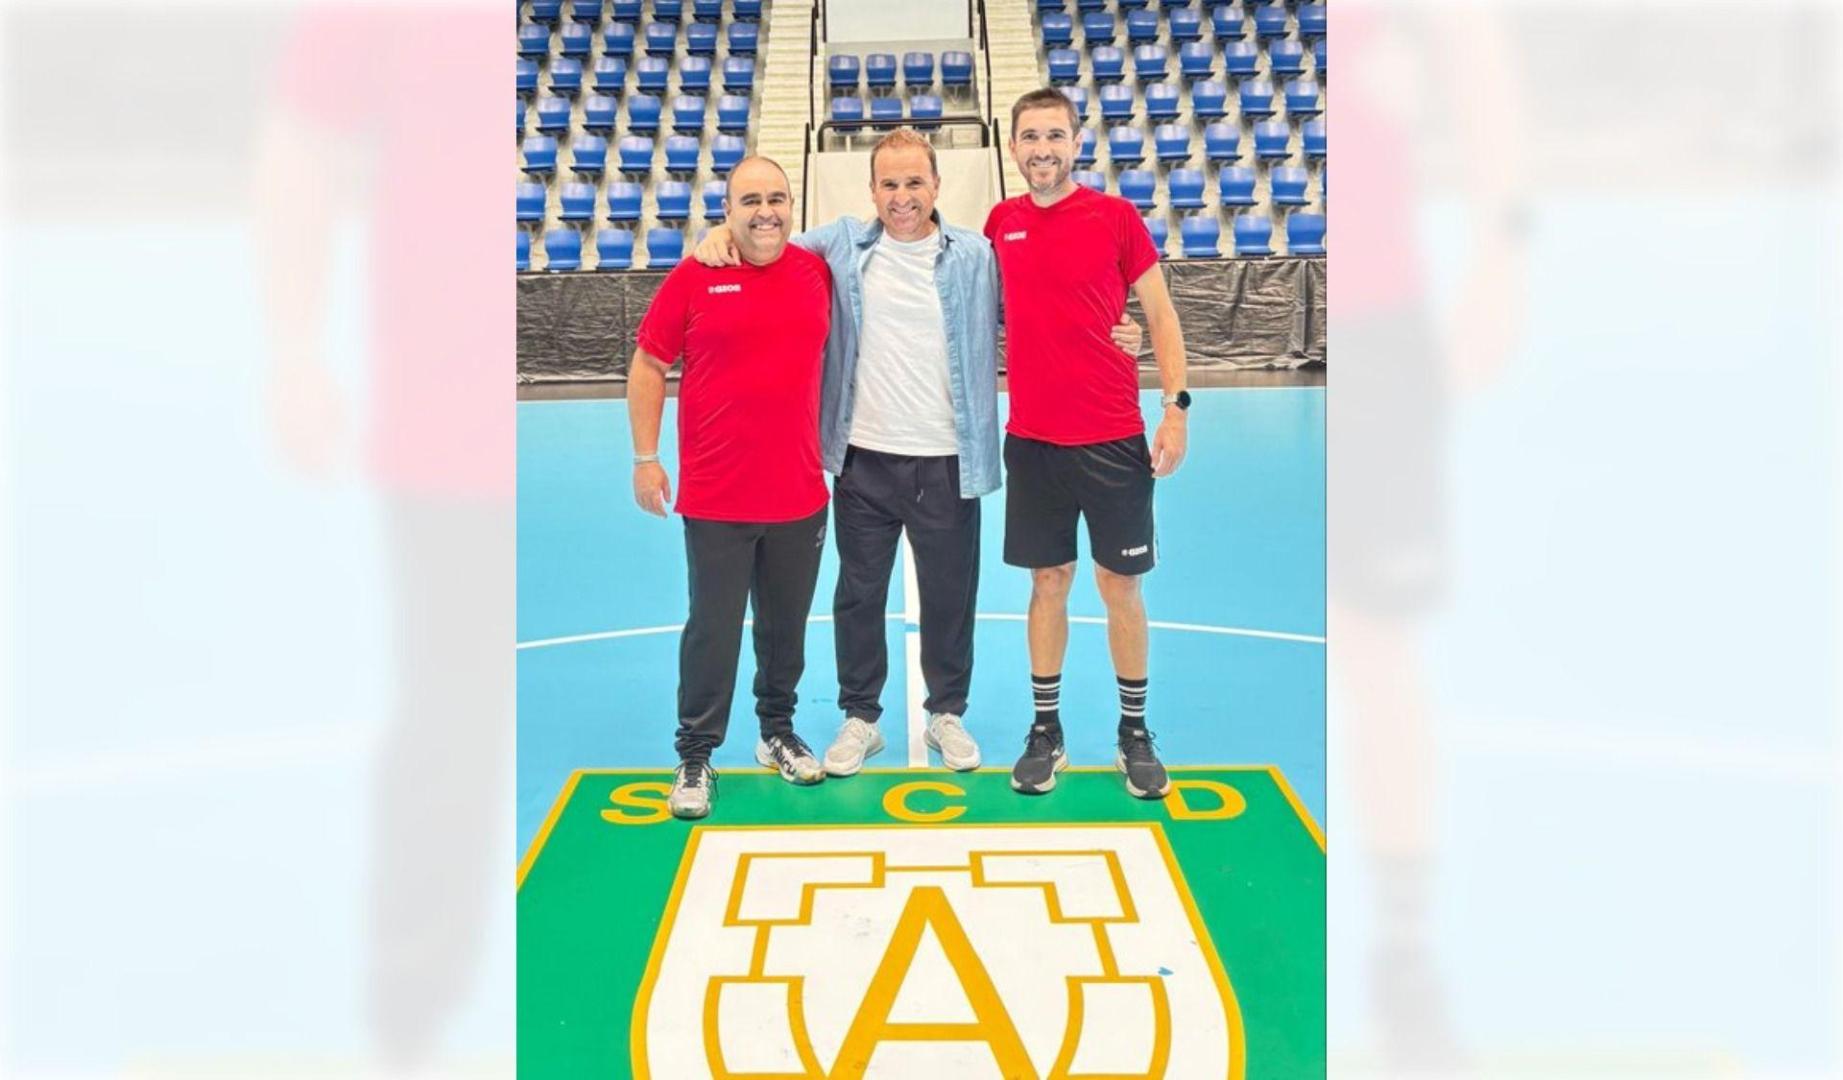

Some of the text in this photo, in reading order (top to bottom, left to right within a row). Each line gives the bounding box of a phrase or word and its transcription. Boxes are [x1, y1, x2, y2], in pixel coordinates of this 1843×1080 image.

[600, 780, 1247, 824] S C D
[827, 886, 1041, 1080] A
